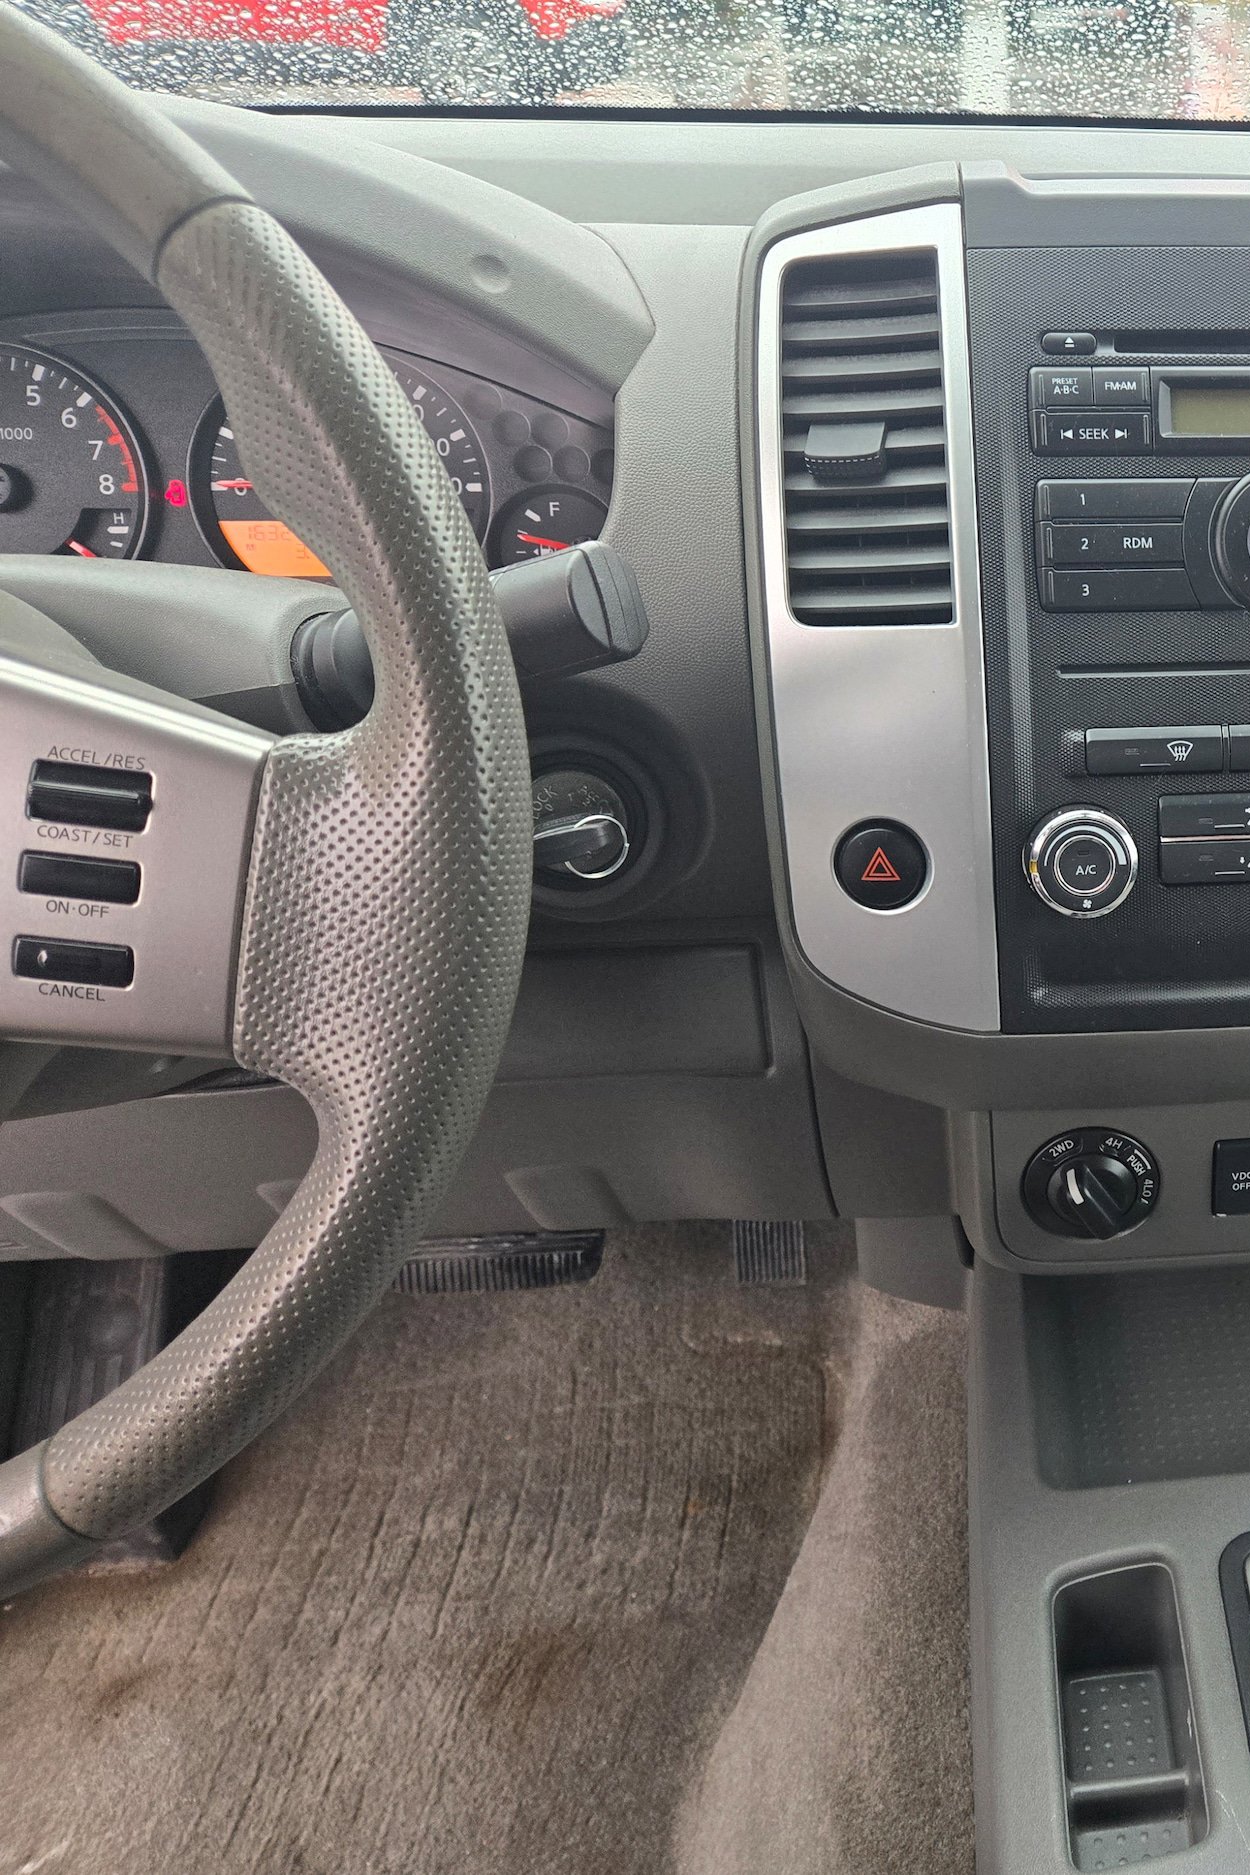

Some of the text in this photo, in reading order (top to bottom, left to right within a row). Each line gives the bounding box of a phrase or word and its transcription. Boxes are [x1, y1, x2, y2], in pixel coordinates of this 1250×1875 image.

[26, 385, 41, 406] 5
[61, 407, 77, 428] 6
[1079, 428, 1109, 440] SEEK
[88, 440, 103, 461] 7
[99, 474, 115, 495] 8
[1080, 493, 1086, 506] 1
[549, 501, 560, 516] F
[113, 512, 125, 524] H
[1081, 537, 1153, 550] 2 RDM
[1082, 584, 1090, 597] 3
[1076, 865, 1097, 876] A/C
[37, 982, 106, 1002] CANCEL
[1048, 1139, 1075, 1158] 2WD
[1105, 1137, 1124, 1150] 4H
[1126, 1154, 1147, 1176] PUSH
